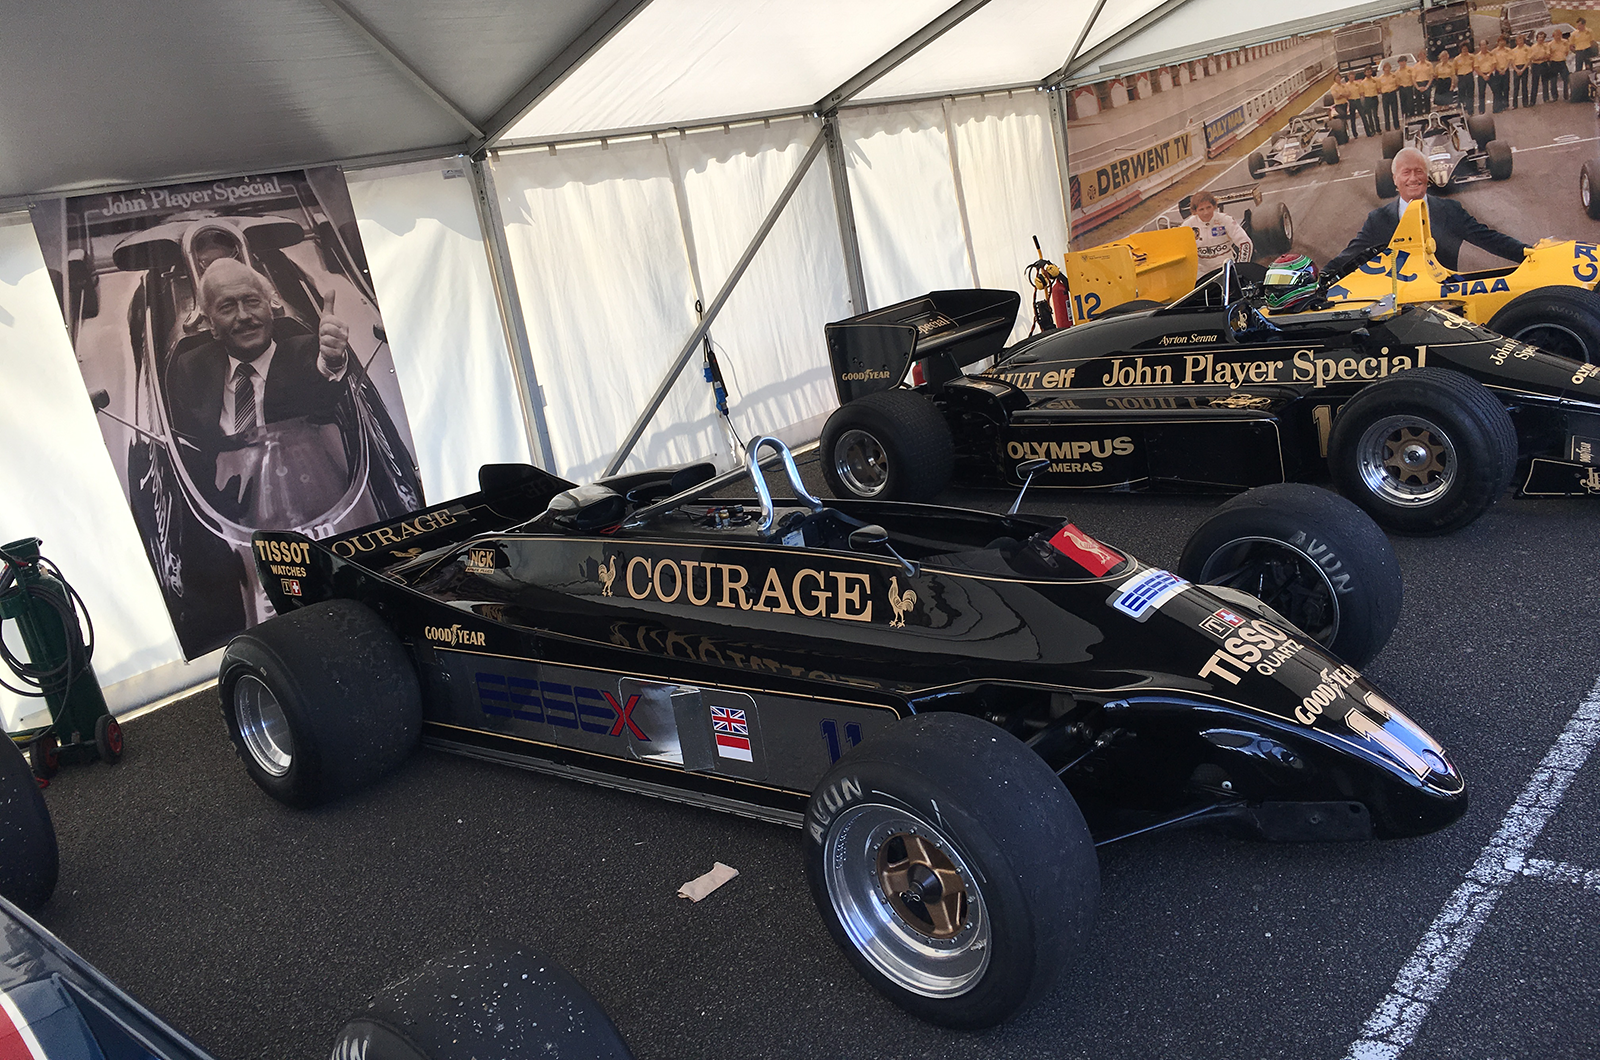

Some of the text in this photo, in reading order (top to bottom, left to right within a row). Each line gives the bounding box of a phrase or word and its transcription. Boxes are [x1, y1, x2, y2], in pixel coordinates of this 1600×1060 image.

[1206, 119, 1228, 142] DAILY
[1096, 141, 1170, 197] DERWENT
[1174, 134, 1190, 159] TV
[102, 176, 281, 216] John Player Special
[1572, 241, 1599, 282] CA
[1441, 278, 1510, 298] PIAA
[1074, 292, 1101, 320] 12
[1547, 305, 1584, 320] AVON
[917, 315, 951, 334] pecial
[1158, 333, 1217, 346] Ayrton Senna
[1103, 346, 1428, 389] John Player Special
[1489, 343, 1516, 366] John
[842, 368, 890, 383] GOODYEAR
[1042, 367, 1076, 388] elf
[1007, 436, 1134, 460] OLYMPUS
[1049, 461, 1103, 473] AMERAS
[331, 508, 457, 559] OURAGE
[255, 540, 311, 565] TISSOT
[470, 550, 494, 568] NGK
[1290, 530, 1354, 595] AVON
[270, 564, 307, 578] WATCHES
[626, 556, 872, 622] COURAGE
[425, 624, 486, 647] GOODYEAR
[1198, 619, 1288, 685] TISSO
[1256, 638, 1305, 676] QUARTZ
[475, 672, 652, 741] ESSEX
[1294, 664, 1363, 725] GOODYEA
[1344, 691, 1445, 781] 11
[809, 776, 864, 846] AVON
